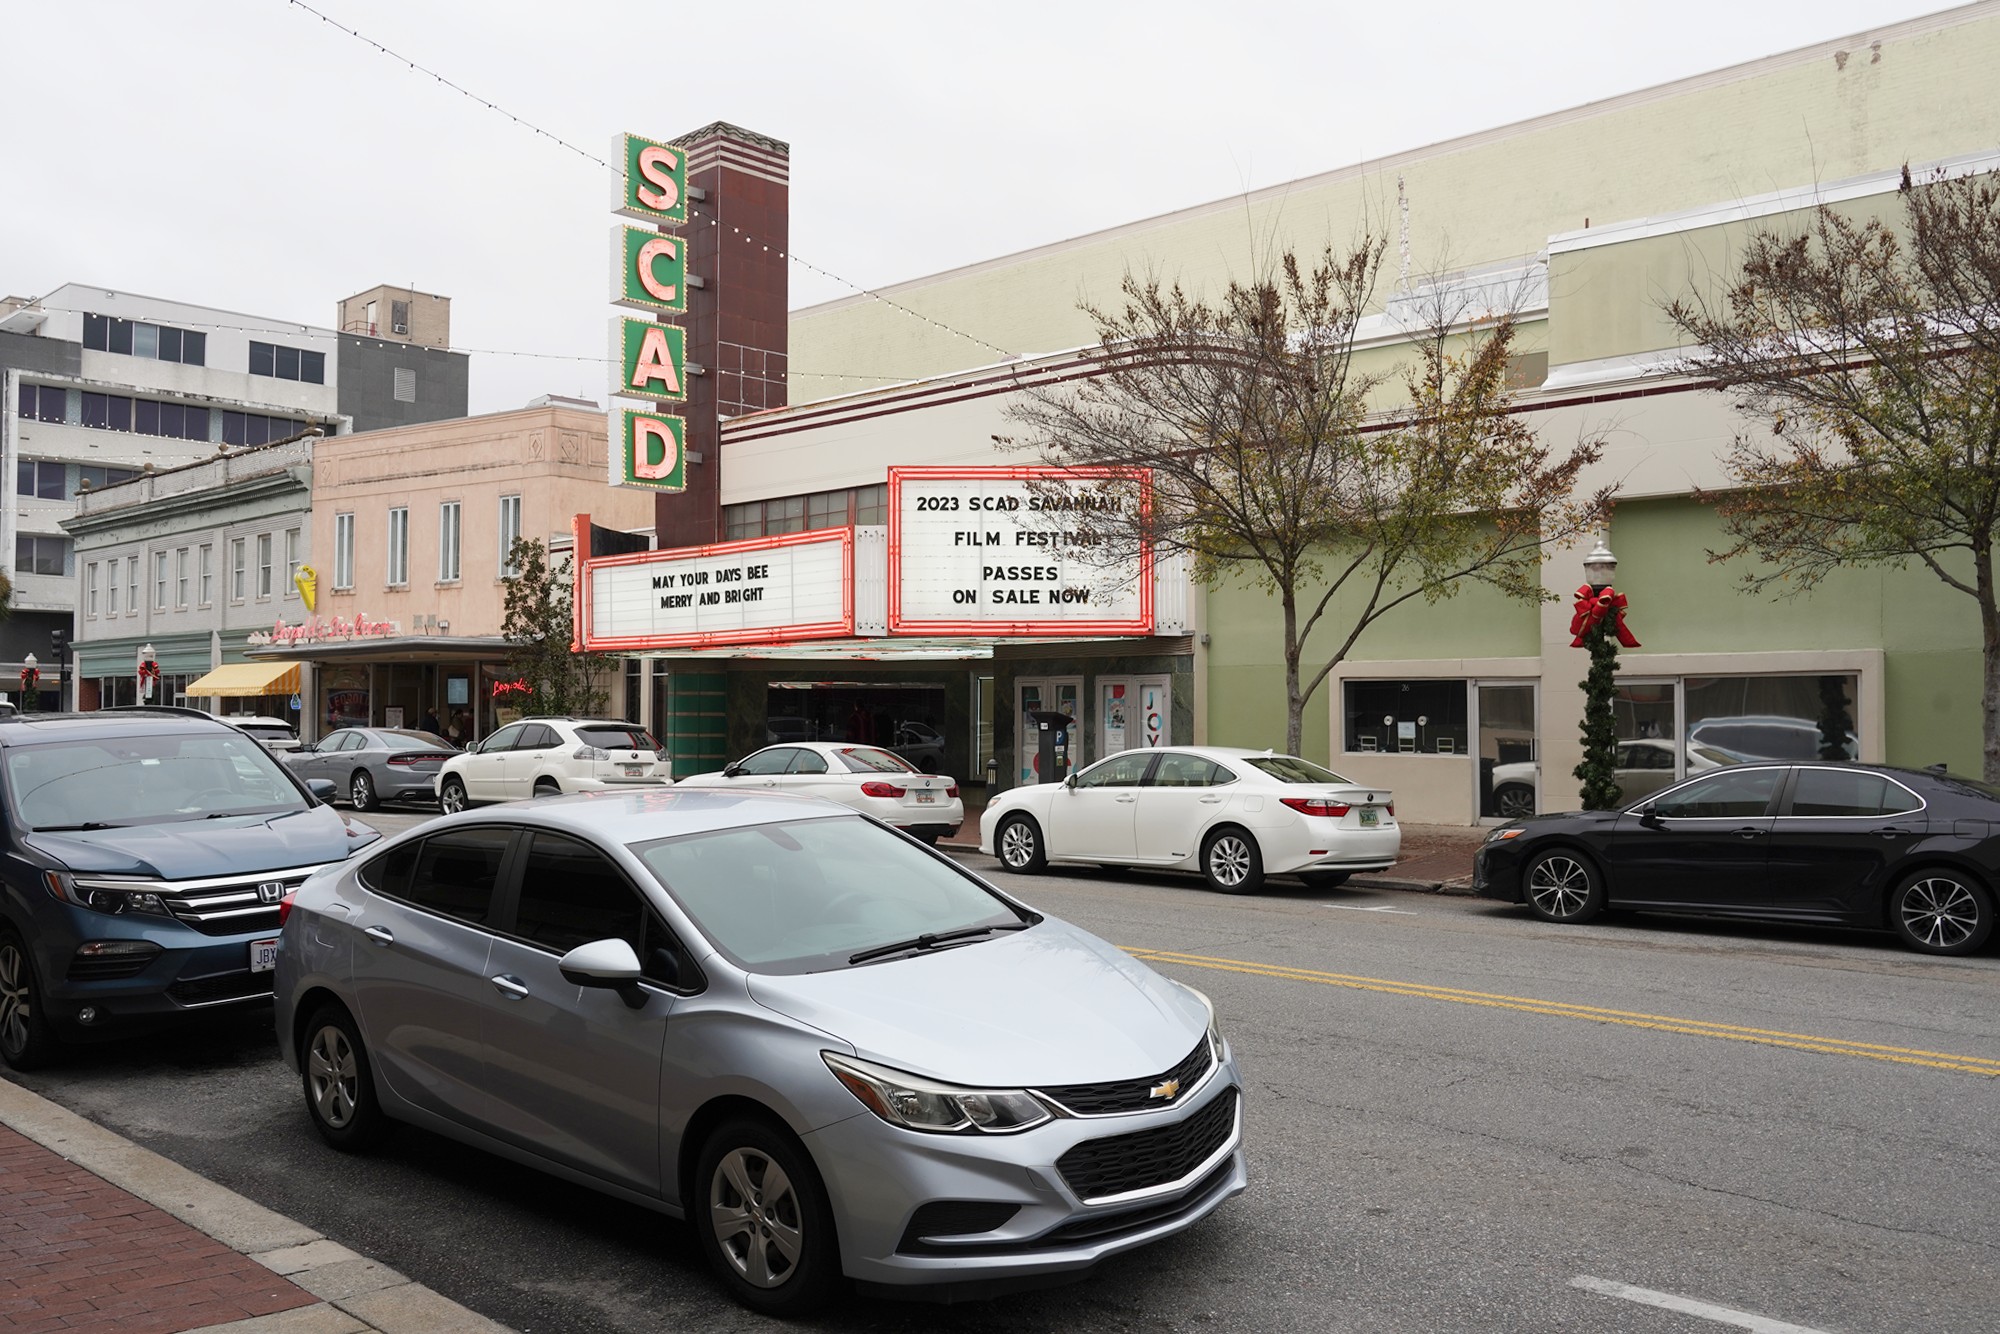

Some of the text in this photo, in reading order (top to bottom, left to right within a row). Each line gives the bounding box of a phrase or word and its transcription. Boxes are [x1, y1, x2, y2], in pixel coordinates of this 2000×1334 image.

[630, 145, 681, 480] SCAD
[917, 497, 1122, 513] 2023 SCAD SAVANNAH
[954, 532, 1102, 547] FILM FESTIVAL
[652, 565, 768, 589] MAY YOUR DAYS BEE
[983, 567, 1058, 580] PASSES
[661, 587, 764, 609] MERRY AND BRIGHT
[953, 590, 1090, 603] ON SALE NOW
[493, 678, 533, 697] Leopolds
